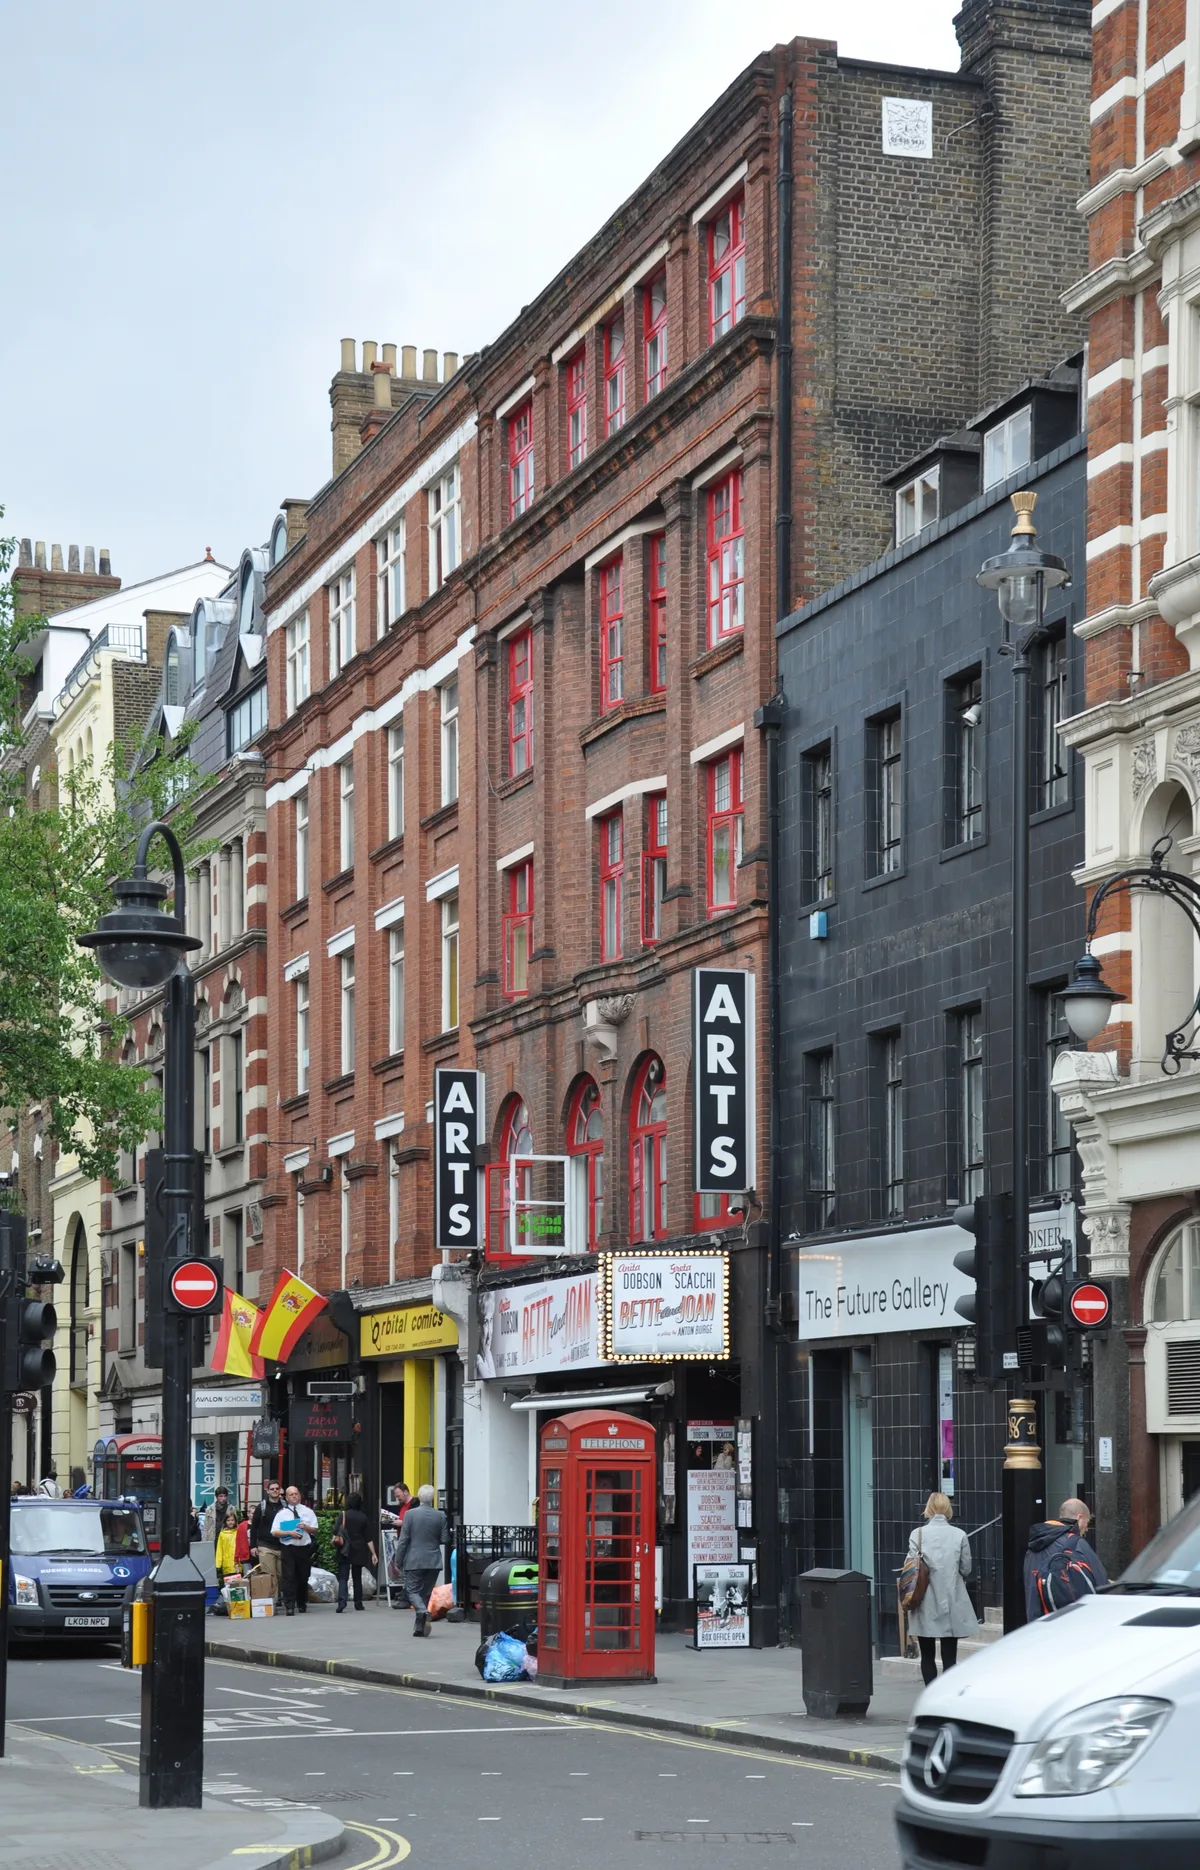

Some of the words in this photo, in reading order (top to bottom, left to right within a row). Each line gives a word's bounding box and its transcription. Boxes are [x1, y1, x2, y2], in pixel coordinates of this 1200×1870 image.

[704, 984, 741, 1177] ARTS
[443, 1082, 474, 1236] ARTS
[618, 1263, 640, 1272] Anita
[670, 1264, 691, 1274] Greta
[624, 1272, 662, 1290] DOBSON
[675, 1272, 715, 1289] SCACCHI
[620, 1298, 664, 1329] BETTE
[676, 1292, 716, 1324] JOAN
[806, 1290, 832, 1320] The
[838, 1285, 887, 1317] Future
[892, 1277, 948, 1316] Gallery
[371, 1312, 408, 1347] Orbital
[412, 1308, 444, 1331] comics
[501, 1310, 518, 1335] DOBSON
[522, 1295, 553, 1366] BETTE
[563, 1278, 591, 1349] JOAN
[677, 1326, 694, 1336] ANTON
[695, 1324, 712, 1335] BURGE
[305, 1429, 339, 1437] FIESTA
[308, 1416, 337, 1425] TAPAS
[584, 1440, 642, 1448] TELEPHONE
[200, 1440, 216, 1494] Nemeta
[702, 1633, 712, 1641] BOX
[713, 1633, 730, 1641] OFFICE
[732, 1632, 745, 1640] OPEN
